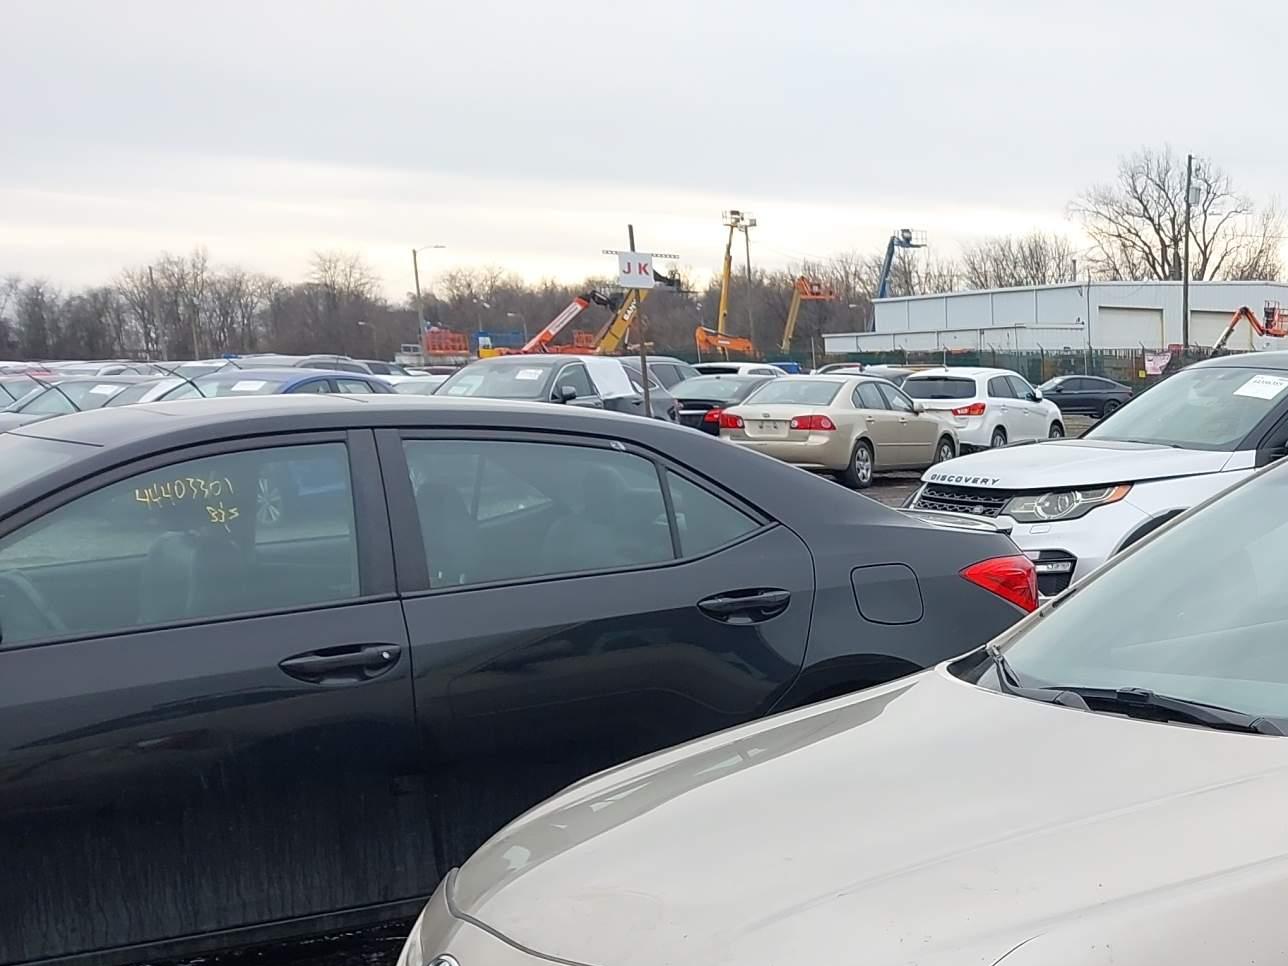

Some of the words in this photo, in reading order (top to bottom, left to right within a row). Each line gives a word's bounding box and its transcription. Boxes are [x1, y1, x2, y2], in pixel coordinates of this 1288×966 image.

[622, 262, 632, 275] J
[638, 262, 649, 275] K
[930, 473, 1000, 485] DISCOVERY
